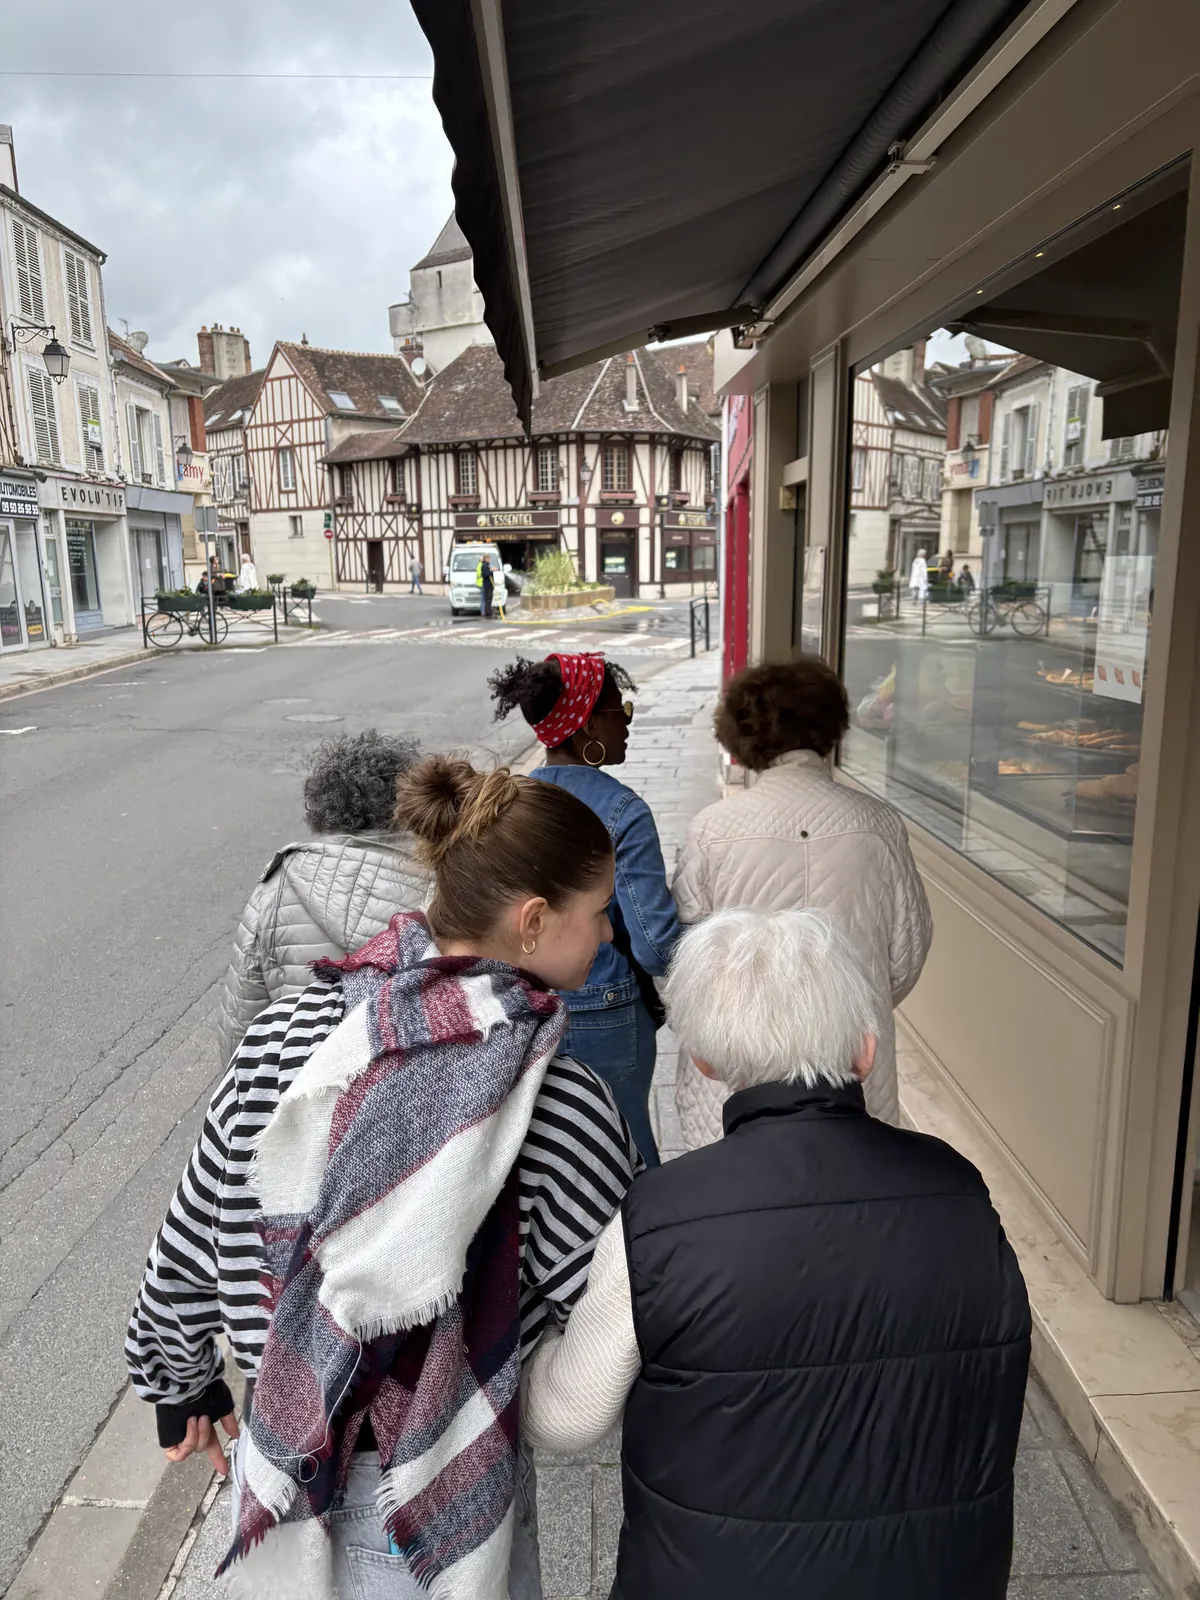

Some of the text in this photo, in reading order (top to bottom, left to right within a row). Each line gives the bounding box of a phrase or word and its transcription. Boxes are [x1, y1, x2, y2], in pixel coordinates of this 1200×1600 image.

[61, 486, 124, 508] EVOLU'TIF
[10, 502, 17, 513] 50
[486, 513, 534, 526] L'ESSENTIEL
